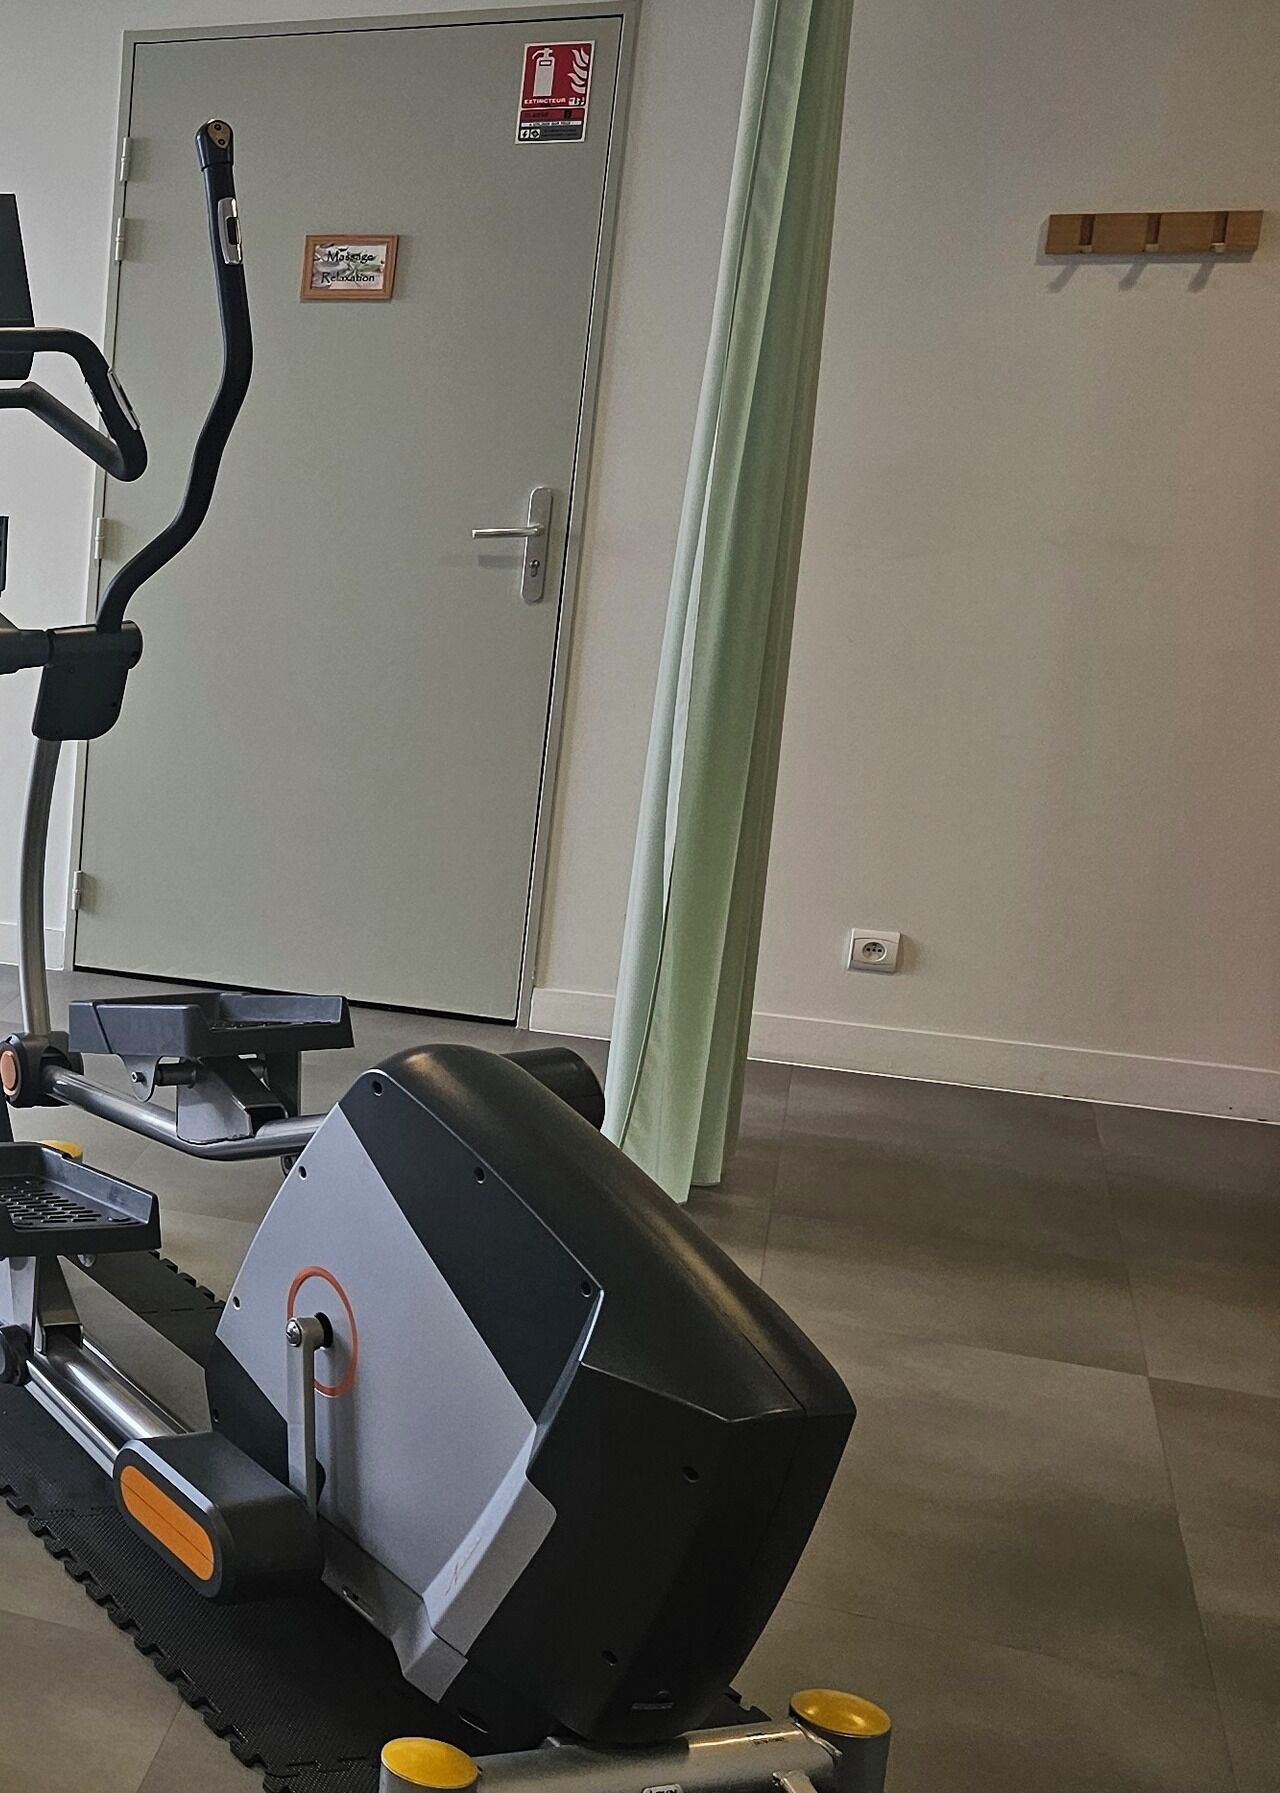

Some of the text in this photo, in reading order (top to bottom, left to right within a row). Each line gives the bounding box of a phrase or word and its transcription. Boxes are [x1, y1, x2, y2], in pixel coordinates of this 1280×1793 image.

[524, 97, 566, 105] EXTINCTEUR
[326, 250, 376, 264] Massage
[321, 271, 375, 284] Relaxation
